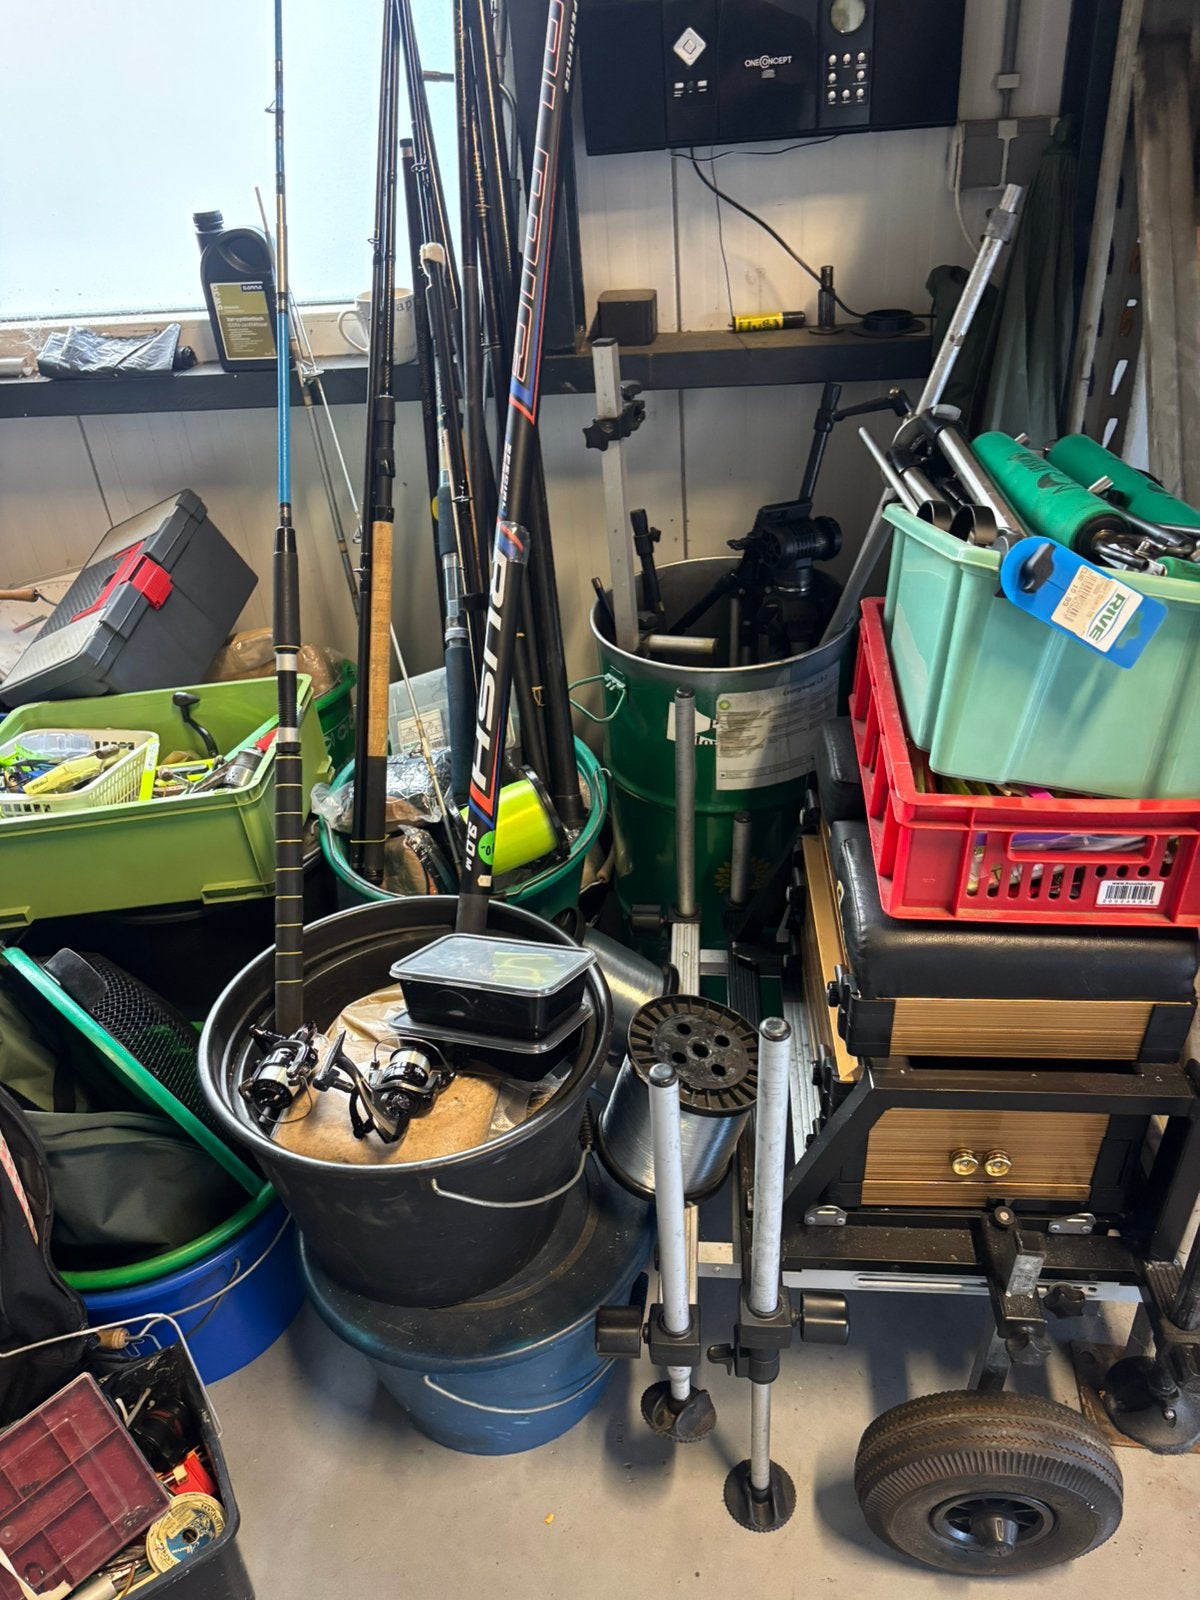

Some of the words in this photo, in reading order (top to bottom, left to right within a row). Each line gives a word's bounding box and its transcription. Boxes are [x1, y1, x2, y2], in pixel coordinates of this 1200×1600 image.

[744, 55, 792, 68] ONECONCEPT
[1089, 593, 1126, 641] RIVE
[471, 549, 508, 790] RUSH
[465, 821, 478, 857] 9.0
